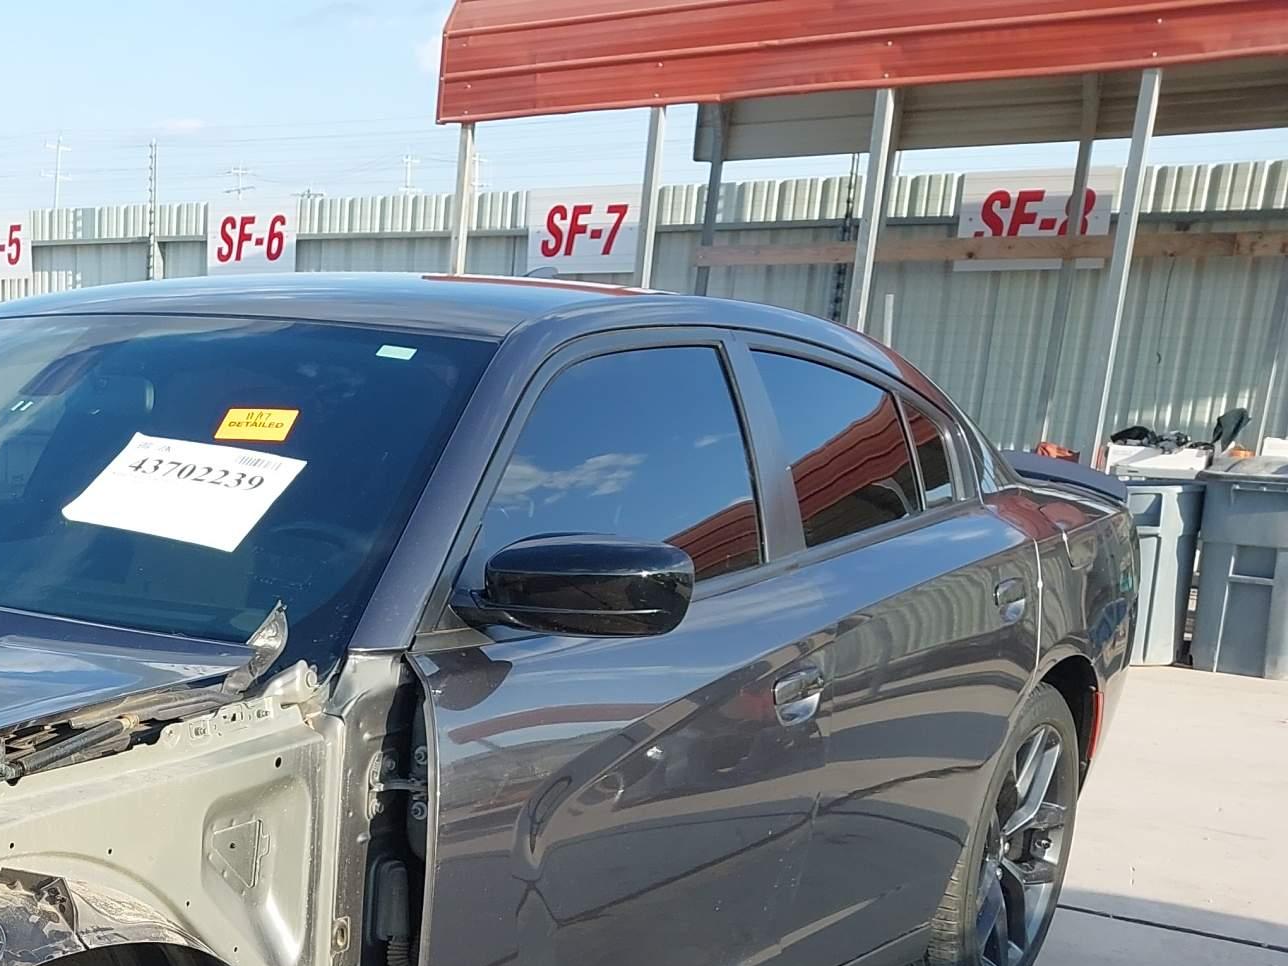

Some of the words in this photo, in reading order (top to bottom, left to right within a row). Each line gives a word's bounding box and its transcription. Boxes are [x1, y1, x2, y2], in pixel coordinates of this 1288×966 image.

[216, 215, 287, 263] SF-6
[540, 203, 629, 257] SF-7
[228, 420, 284, 429] DETAILED
[128, 456, 264, 491] 43702239
